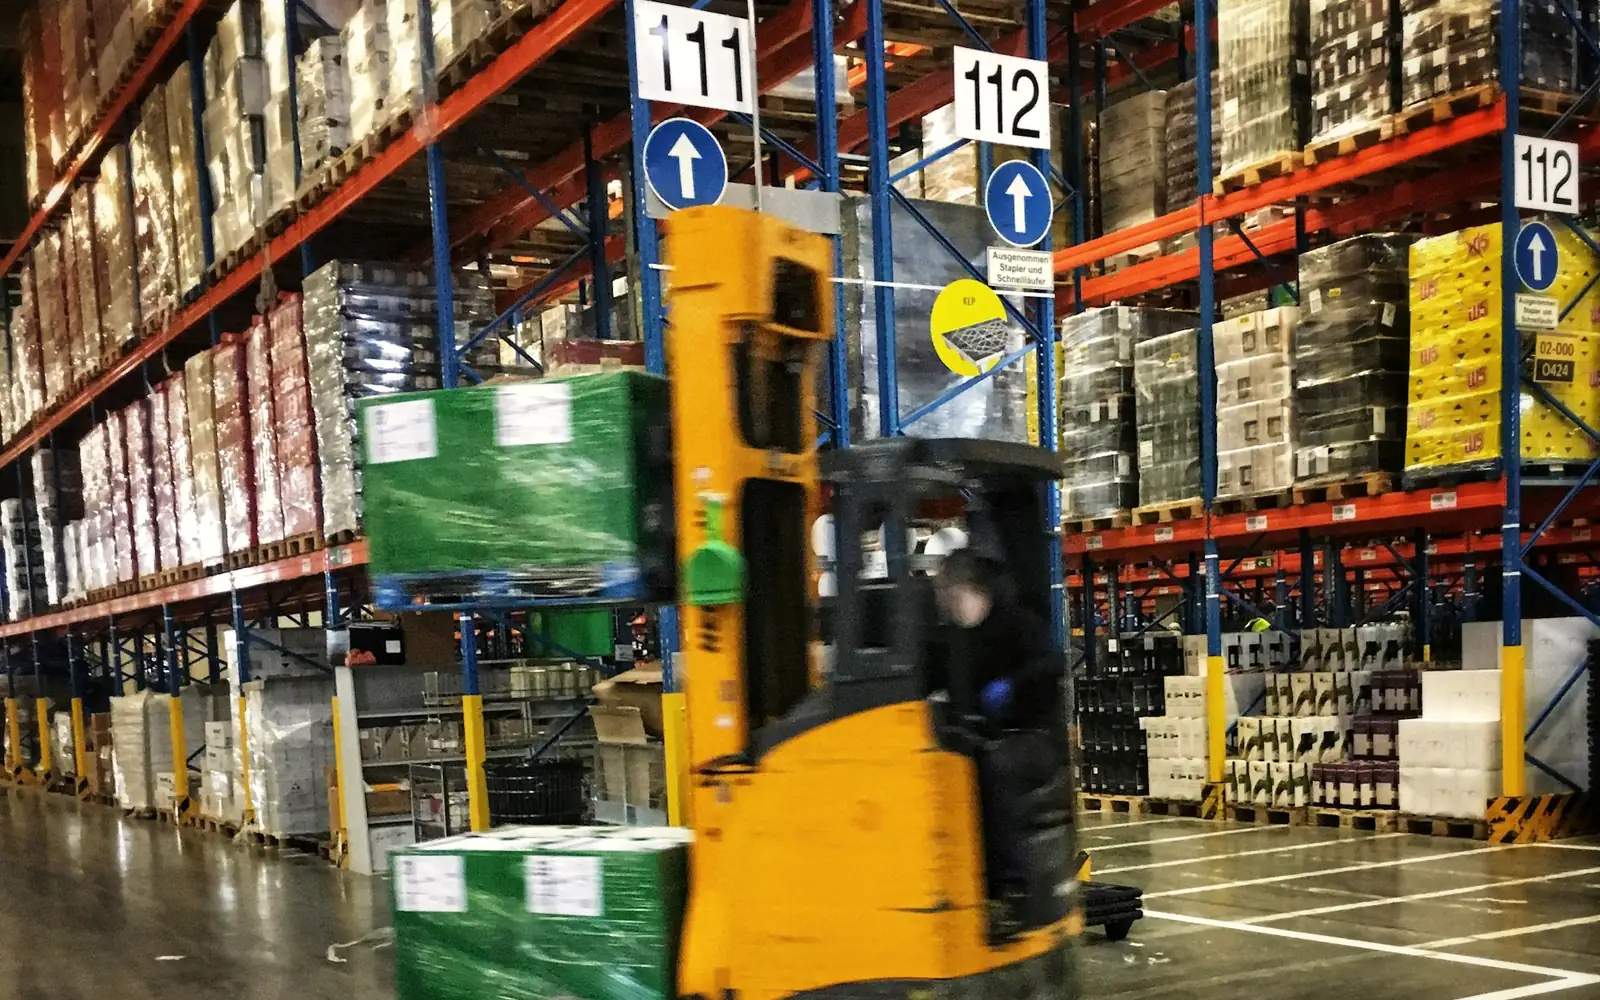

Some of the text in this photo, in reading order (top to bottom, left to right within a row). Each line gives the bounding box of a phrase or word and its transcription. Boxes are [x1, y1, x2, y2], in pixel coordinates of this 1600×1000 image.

[649, 14, 743, 102] 111
[965, 60, 1040, 138] 112
[1522, 145, 1572, 206] 112
[993, 251, 1049, 264] Ausgenommen
[1000, 262, 1026, 274] Stapler
[963, 297, 976, 306] KLP
[1540, 341, 1574, 356] 02-000
